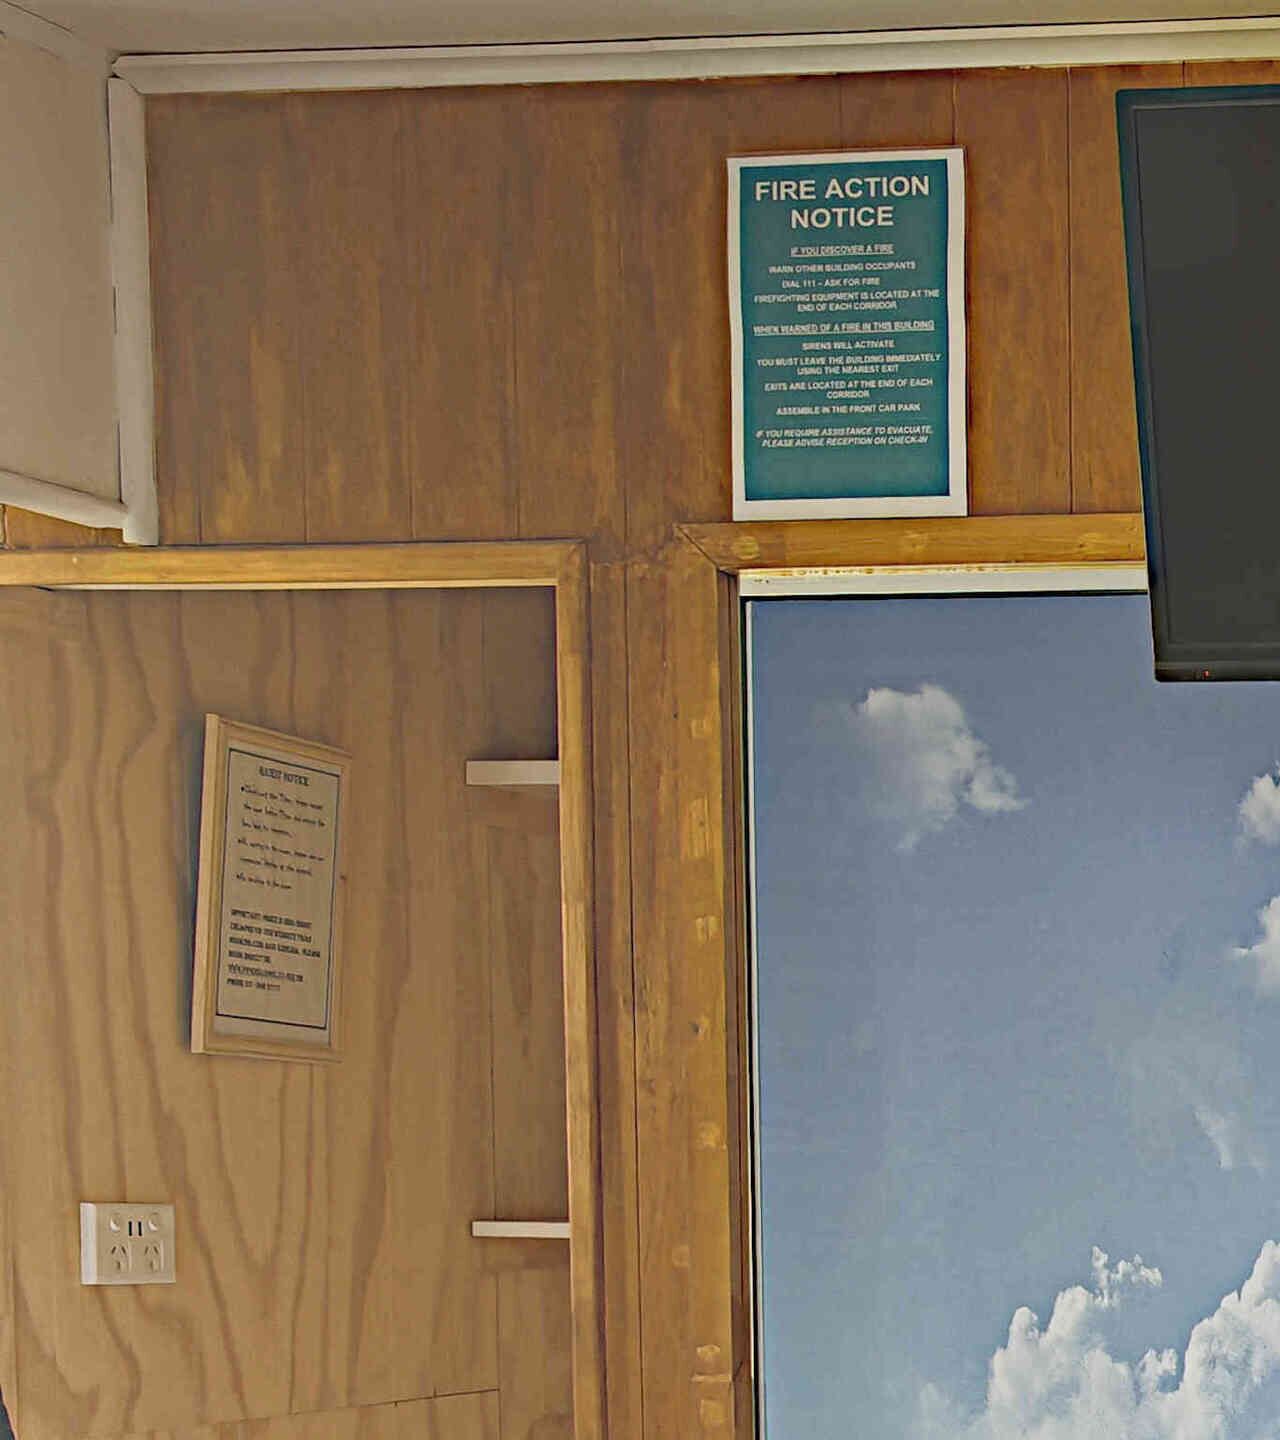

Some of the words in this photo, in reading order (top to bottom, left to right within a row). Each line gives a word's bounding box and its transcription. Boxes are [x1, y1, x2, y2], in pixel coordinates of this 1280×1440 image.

[755, 180, 816, 201] FIRE
[825, 176, 929, 199] ACTION
[791, 206, 894, 229] NOTICE
[801, 247, 819, 256] YOU
[821, 245, 864, 256] DISCOVER
[866, 245, 873, 254] A
[874, 244, 893, 254] FIRE
[768, 265, 794, 274] WARN
[795, 264, 823, 273] OTHER
[825, 263, 863, 272] BUILDING
[865, 261, 915, 271] OCCUPANTS
[782, 280, 801, 289] DIAL
[804, 279, 816, 287] 111
[824, 278, 841, 287] ASK
[843, 278, 860, 286] FOR
[862, 277, 880, 286] FIRE
[754, 293, 810, 303] FIREFIGHTING
[812, 292, 859, 302] EQUIPMENT
[860, 292, 869, 300] IS
[870, 291, 910, 300] LOCATED
[911, 290, 923, 299] AT
[925, 289, 939, 298] THE
[797, 304, 814, 312] END
[816, 303, 827, 311] OF
[829, 302, 851, 311] EACH
[853, 301, 897, 310] CORRIDOR
[753, 325, 779, 336] WHEN
[781, 324, 817, 335] WARNED
[820, 323, 831, 334] OF
[842, 322, 861, 334] FIRE
[863, 322, 872, 333] IN
[874, 321, 892, 333] THIS
[894, 320, 934, 332] BUILDING
[802, 342, 831, 350] SIRENS
[833, 342, 853, 350] WILL
[854, 340, 894, 349] ACTIVATE
[757, 359, 775, 367] YOU
[776, 358, 798, 366] MUST
[800, 357, 826, 365] LEAVE
[828, 356, 844, 364] THE
[846, 355, 884, 364] BUILDING
[886, 353, 941, 363] IMMEDIATELY
[797, 367, 823, 376] USING
[825, 367, 840, 375] THE
[842, 365, 879, 374] NEAREST
[881, 364, 898, 373] EXIT
[765, 383, 787, 391] EXITS
[789, 382, 806, 390] ARE
[808, 381, 846, 390] LOCATED
[847, 380, 859, 388] AT
[861, 380, 877, 388] THE
[878, 379, 895, 387] END
[897, 379, 908, 387] OF
[910, 378, 933, 387] EACH
[826, 391, 870, 399] CORRIDOR
[776, 405, 820, 415] ASSEMBLE
[821, 405, 831, 414] IN
[832, 404, 848, 413] THE
[849, 404, 877, 413] FRONT
[878, 404, 897, 412] CAR
[898, 403, 921, 412] PARK
[756, 430, 764, 438] IF
[765, 430, 783, 438] YOU
[784, 429, 820, 437] REQUIRE
[822, 427, 873, 436] ASSISTANCE
[762, 439, 794, 447] PLEASE
[795, 438, 825, 447] ADVISE
[826, 437, 872, 445] RECEPTION
[873, 436, 886, 445] ON
